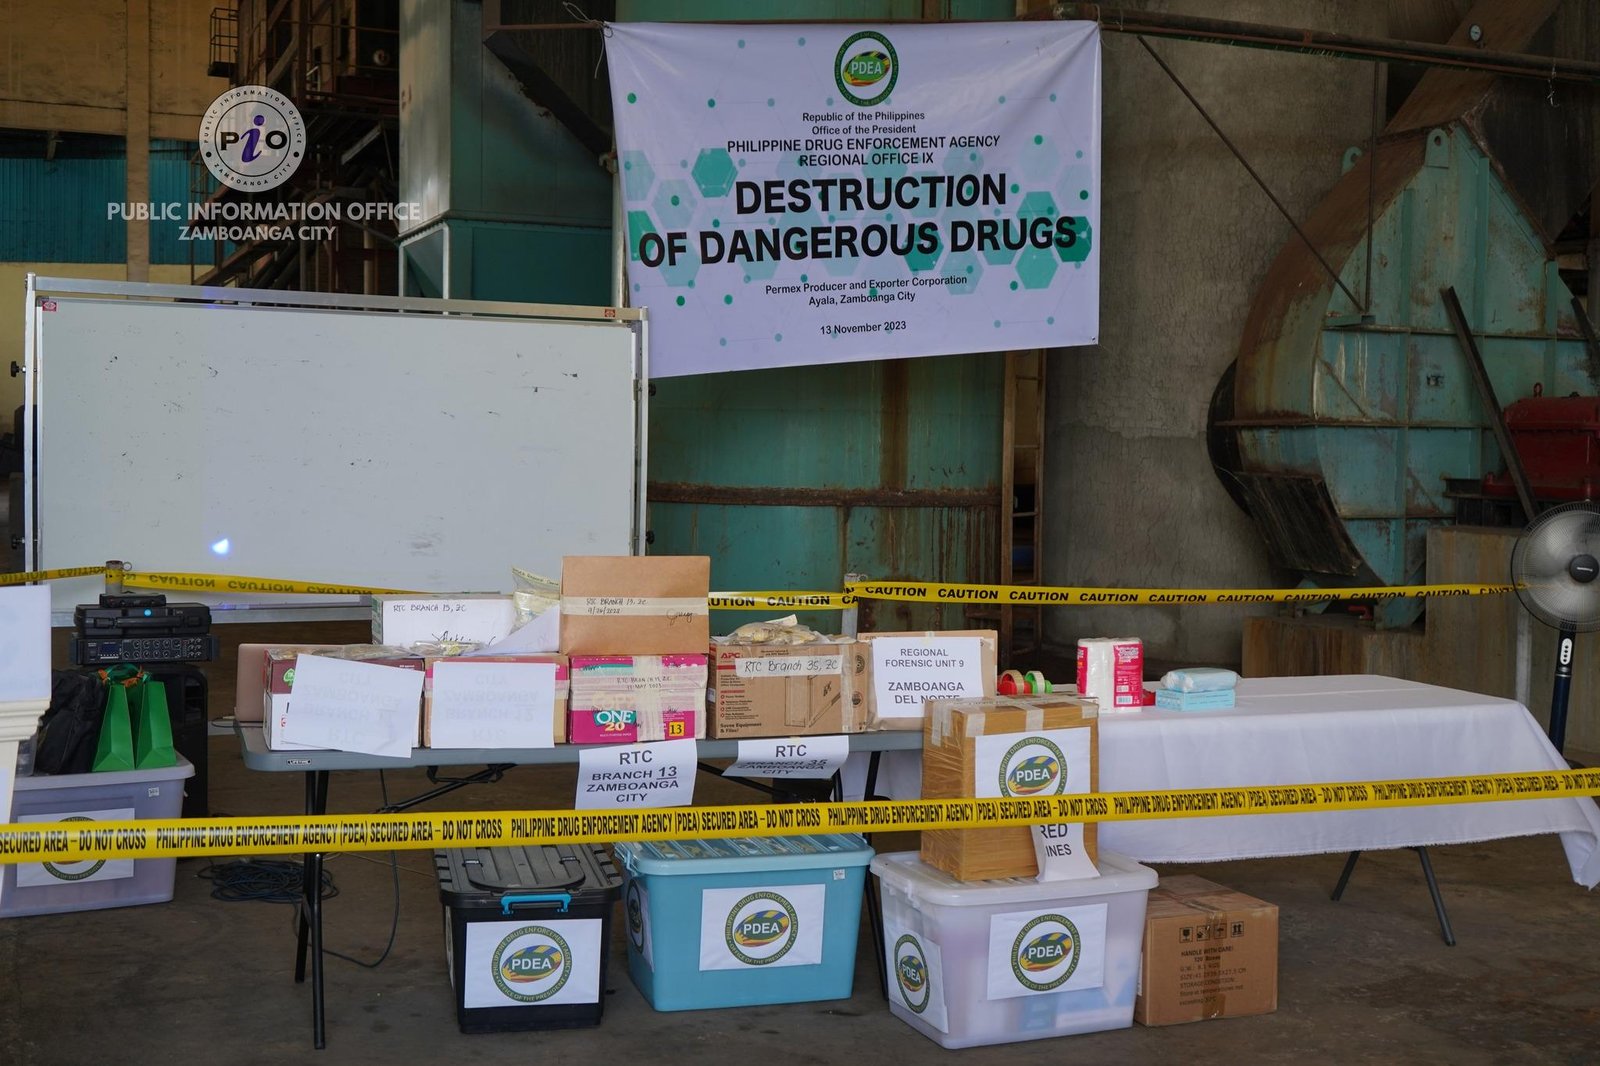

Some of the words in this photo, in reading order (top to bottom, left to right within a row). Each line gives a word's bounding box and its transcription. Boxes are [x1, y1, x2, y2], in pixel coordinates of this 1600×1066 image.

[852, 61, 882, 74] PDEA
[802, 112, 843, 123] Republic
[845, 112, 855, 121] of
[858, 112, 873, 121] the
[874, 110, 925, 122] Philippines
[812, 125, 840, 135] Office
[842, 125, 852, 134] of
[855, 125, 870, 134] the
[872, 124, 916, 134] President
[727, 139, 802, 153] PHILIPPINE
[804, 138, 842, 152] DRUG
[847, 136, 946, 150] ENFORCEMENT
[948, 135, 1000, 148] AGENCY
[799, 154, 868, 167] REGIONAL
[870, 152, 918, 166] OFFICE
[922, 152, 934, 164] IX
[736, 172, 1006, 214] DESTRUCTION
[640, 232, 687, 268] OF
[700, 222, 938, 264] DANGEROUS
[950, 216, 1077, 252] DRUGS
[765, 284, 801, 294] Permex
[804, 282, 847, 292] Producer
[849, 280, 867, 289] and
[869, 278, 910, 292] Exporter
[912, 275, 967, 288] Corporation
[808, 294, 838, 307] Ayala,
[840, 292, 896, 306] Zamboanga
[898, 290, 916, 304] City
[820, 325, 832, 335] 13
[834, 323, 881, 334] November
[884, 320, 907, 331] 2023
[865, 586, 926, 597] CAUTION
[938, 588, 998, 600] CAUTION
[1008, 590, 1069, 601] CAUTION
[1080, 593, 1138, 602] CAUTION
[1148, 594, 1206, 602] CAUTION
[1284, 593, 1340, 601] CAUTION
[1350, 591, 1406, 600] CAUTION
[1416, 589, 1470, 599] CAUTION
[767, 596, 830, 607] CAUTION
[900, 648, 949, 657] REGIONAL
[745, 662, 762, 672] RTC
[768, 660, 802, 672] Branch
[888, 682, 965, 691] ZAMBOANGA
[895, 695, 918, 704] DEL
[596, 711, 633, 723] ONE
[605, 722, 625, 731] 20
[670, 725, 682, 734] 13
[619, 750, 653, 765] RTC
[775, 745, 807, 757] RTC
[592, 770, 652, 781] BRANCH
[658, 766, 678, 778] 13
[1016, 768, 1050, 783] PDEA
[586, 780, 679, 792] ZAMBOANGA
[616, 793, 648, 803] CITY
[0, 831, 41, 854] SECURED
[44, 830, 69, 852] AREA
[79, 830, 92, 851] DO
[93, 829, 114, 850] NOT
[116, 828, 146, 850] CROSS
[156, 827, 206, 849] PHILIPPINE
[208, 826, 233, 847] DRUG
[236, 824, 300, 847] ENFORCEMENT
[302, 823, 338, 845] AGENCY
[340, 821, 368, 845] (PDEA)
[370, 821, 409, 843] SECURED
[411, 821, 433, 841] AREA
[442, 820, 454, 840] DO
[456, 820, 473, 839] NOT
[476, 819, 502, 839] CROSS
[511, 817, 555, 838] PHILIPPINE
[558, 816, 580, 836] DRUG
[582, 814, 639, 835] ENFORCEMENT
[642, 813, 672, 833] AGENCY
[675, 811, 700, 834] (PDEA)
[702, 811, 737, 831] SECURED
[739, 811, 758, 829] AREA
[766, 810, 778, 828] DO
[779, 809, 794, 827] NOT
[797, 809, 820, 826] CROSS
[828, 807, 868, 826] PHILIPPINE
[870, 806, 890, 824] DRUG
[892, 804, 943, 823] ENFORCEMENT
[946, 803, 973, 822] AGENCY
[976, 801, 998, 823] (PDEA)
[1000, 800, 1031, 820] SECURED
[1034, 800, 1052, 818] AREA
[1059, 800, 1069, 817] DO
[1070, 799, 1084, 816] NOT
[1086, 798, 1108, 815] CROSS
[1115, 797, 1150, 814] PHILIPPINE
[1152, 796, 1171, 813] DRUG
[1172, 793, 1219, 812] ENFORCEMENT
[1221, 792, 1246, 809] AGENCY
[1248, 789, 1268, 809] (PDEA)
[1269, 789, 1298, 806] SECURED
[1300, 788, 1317, 804] AREA
[1322, 787, 1332, 803] DO
[1333, 786, 1345, 802] NOT
[1346, 786, 1368, 802] CROSS
[743, 922, 780, 935] PDEA
[1028, 944, 1063, 959] PDEA
[511, 957, 552, 970] PDEA
[902, 965, 921, 984] PDEA
